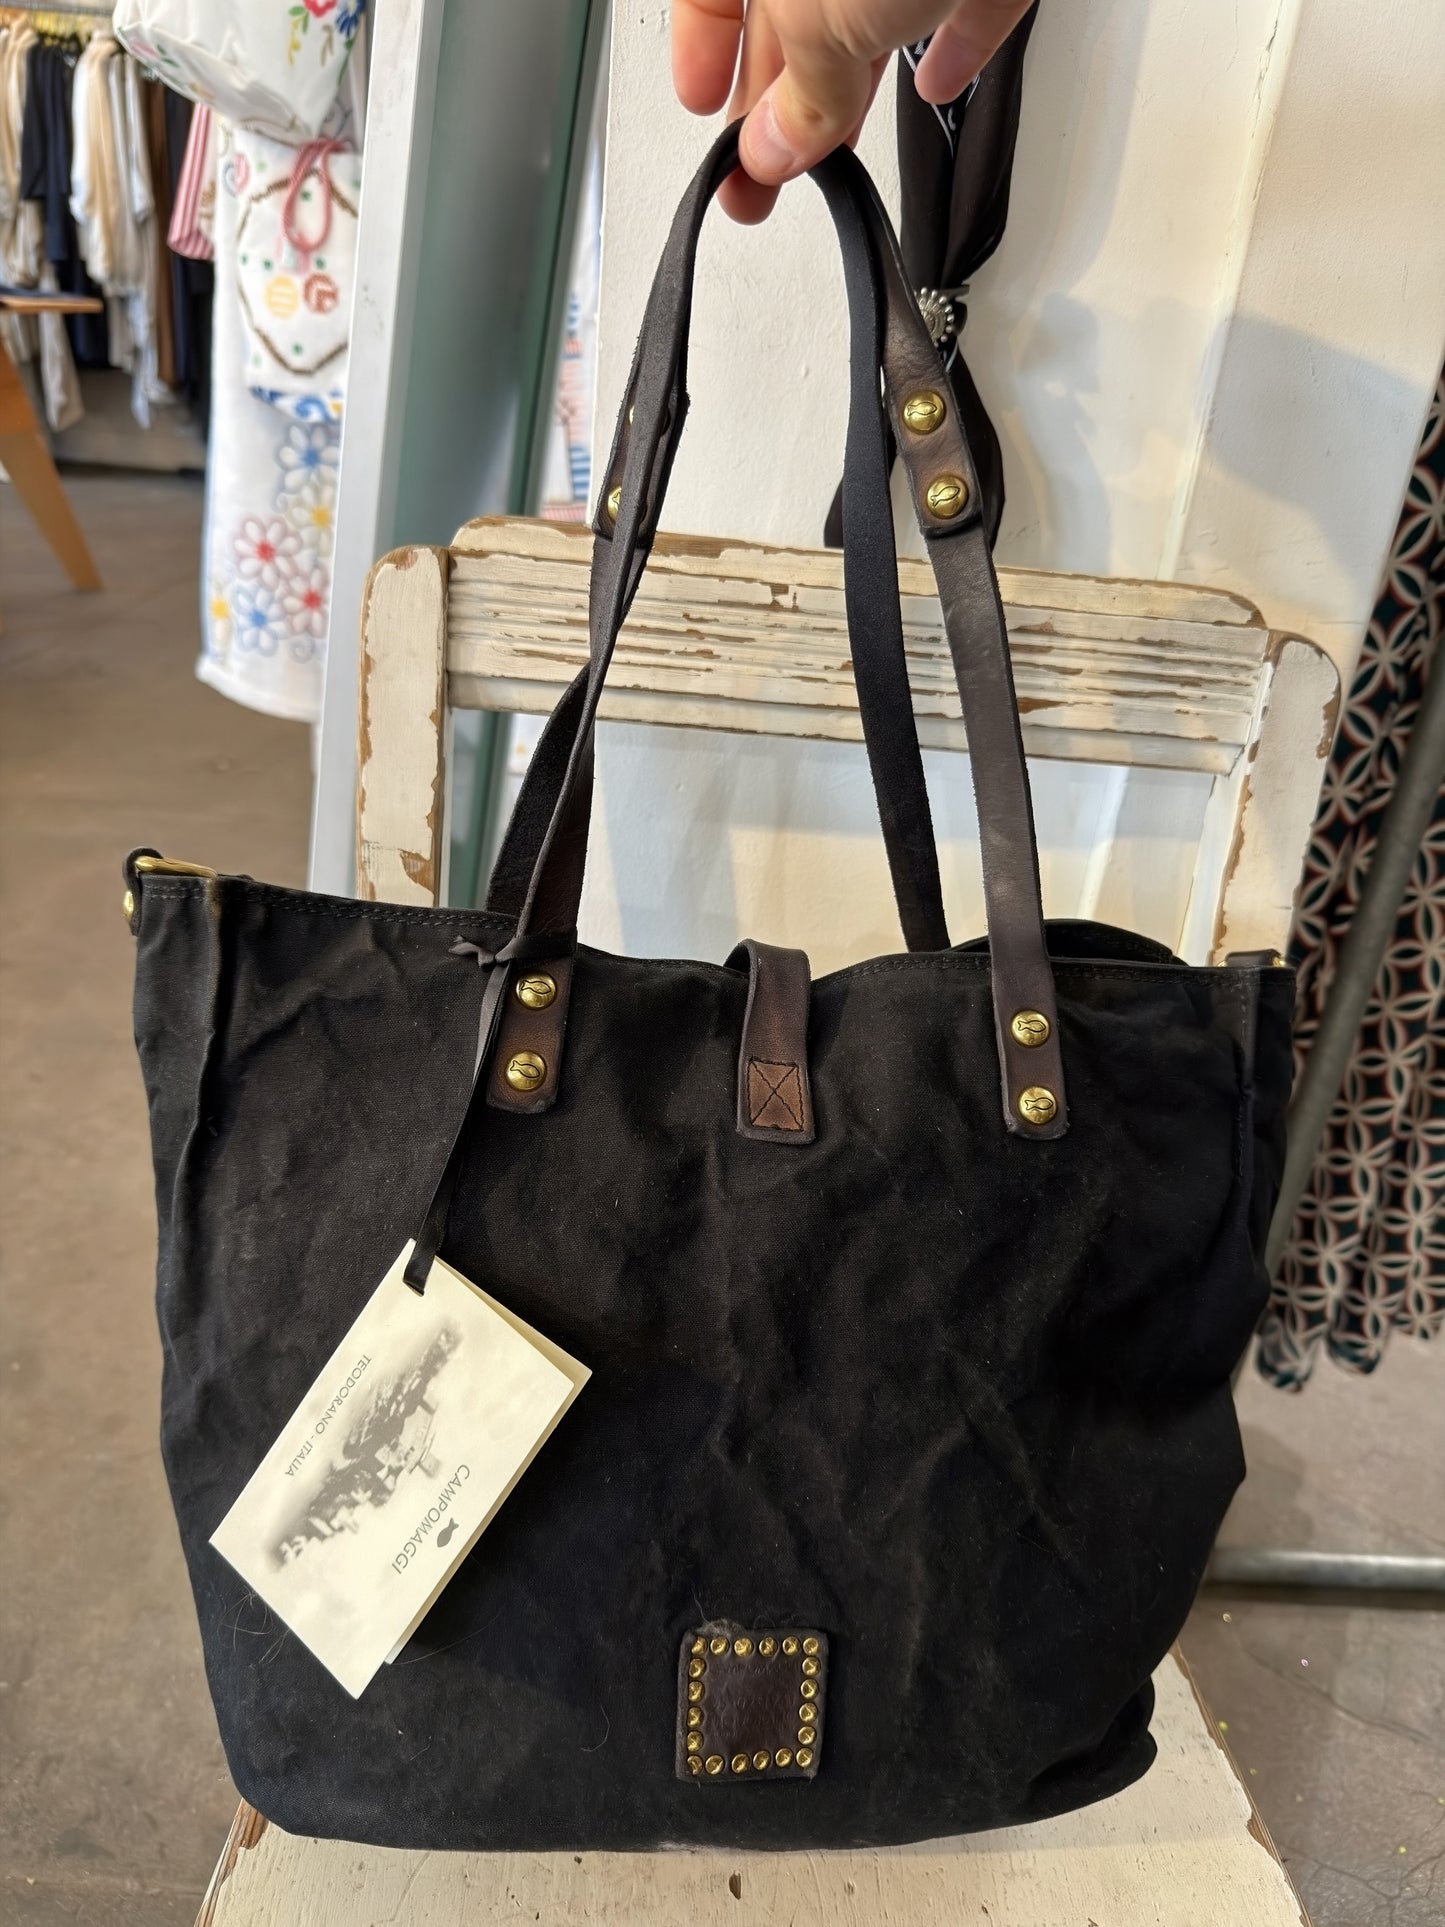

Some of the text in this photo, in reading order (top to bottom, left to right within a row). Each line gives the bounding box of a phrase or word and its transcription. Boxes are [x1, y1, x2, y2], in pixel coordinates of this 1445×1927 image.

[315, 1354, 372, 1434] TEODORANO
[285, 1440, 313, 1476] ITALIA
[391, 1464, 470, 1574] CAMPOMAGGI
